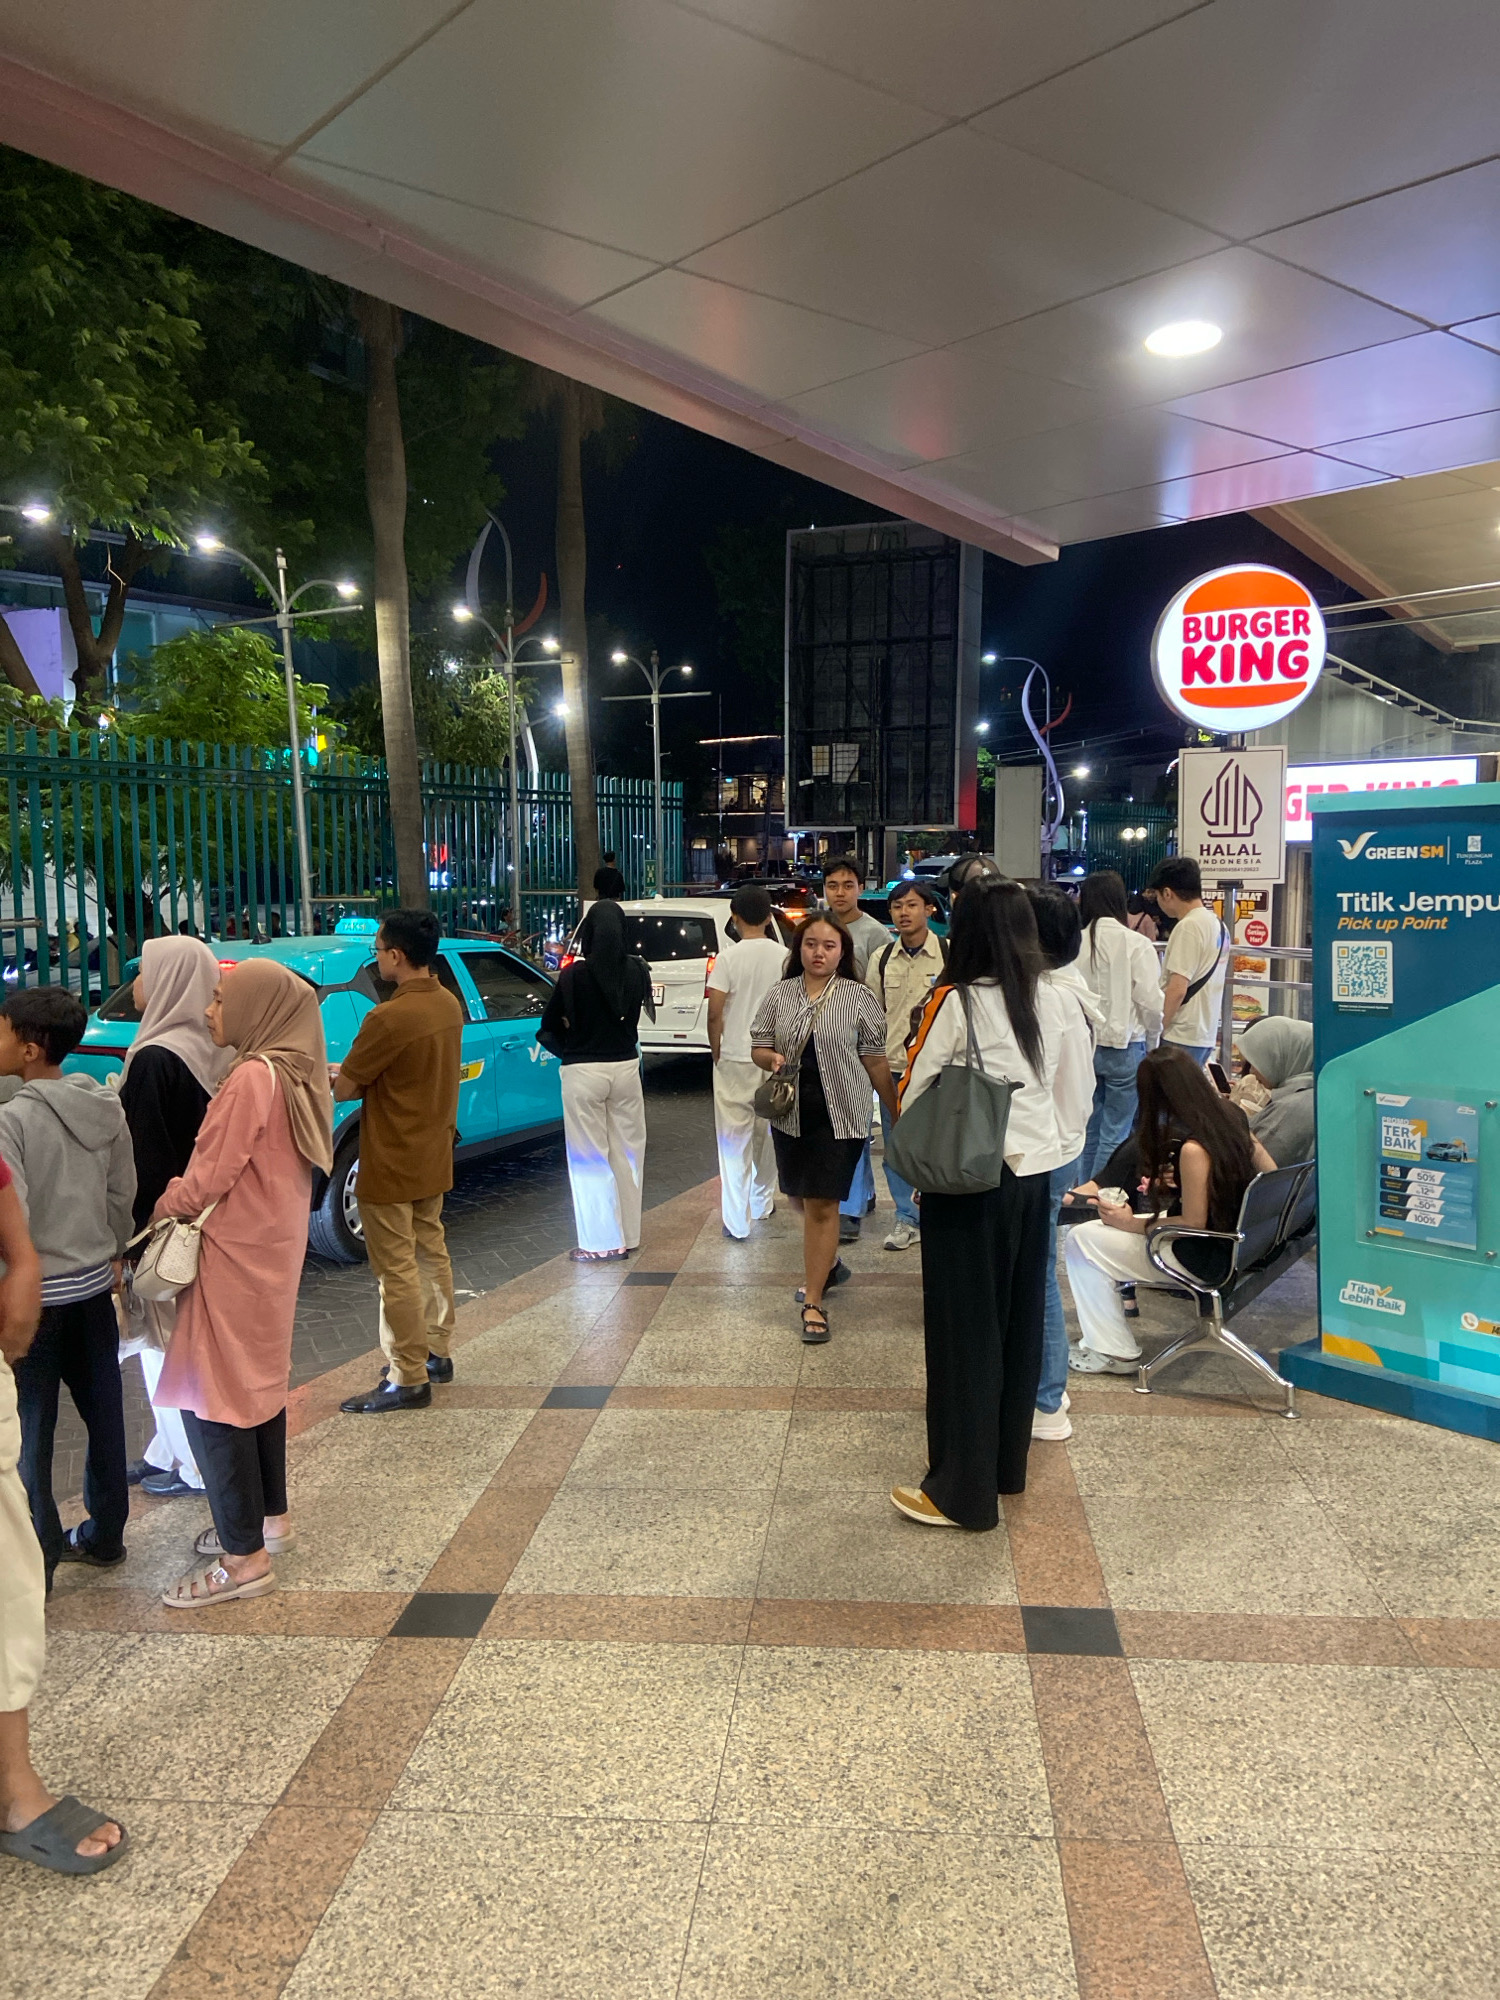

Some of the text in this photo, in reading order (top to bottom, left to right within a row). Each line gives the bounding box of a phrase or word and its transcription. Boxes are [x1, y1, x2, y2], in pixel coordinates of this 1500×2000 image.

[1183, 608, 1311, 643] BURGER
[1181, 639, 1309, 686] KING
[1200, 843, 1261, 856] HALAL
[1365, 845, 1444, 860] GREEN SM
[1456, 852, 1492, 860] TUNJUNGAN
[1201, 891, 1262, 901] SUPE EMAT
[1336, 892, 1395, 913] Titik
[1337, 917, 1448, 933] Pick up Point
[1382, 1116, 1410, 1125] PROMO
[1383, 1125, 1410, 1138] TER
[1384, 1136, 1416, 1150] BAIK
[1417, 1173, 1436, 1183] 50%
[1414, 1214, 1437, 1225] 100%
[1351, 1282, 1375, 1296] Tiba
[1342, 1291, 1401, 1311] Lebih Baik
